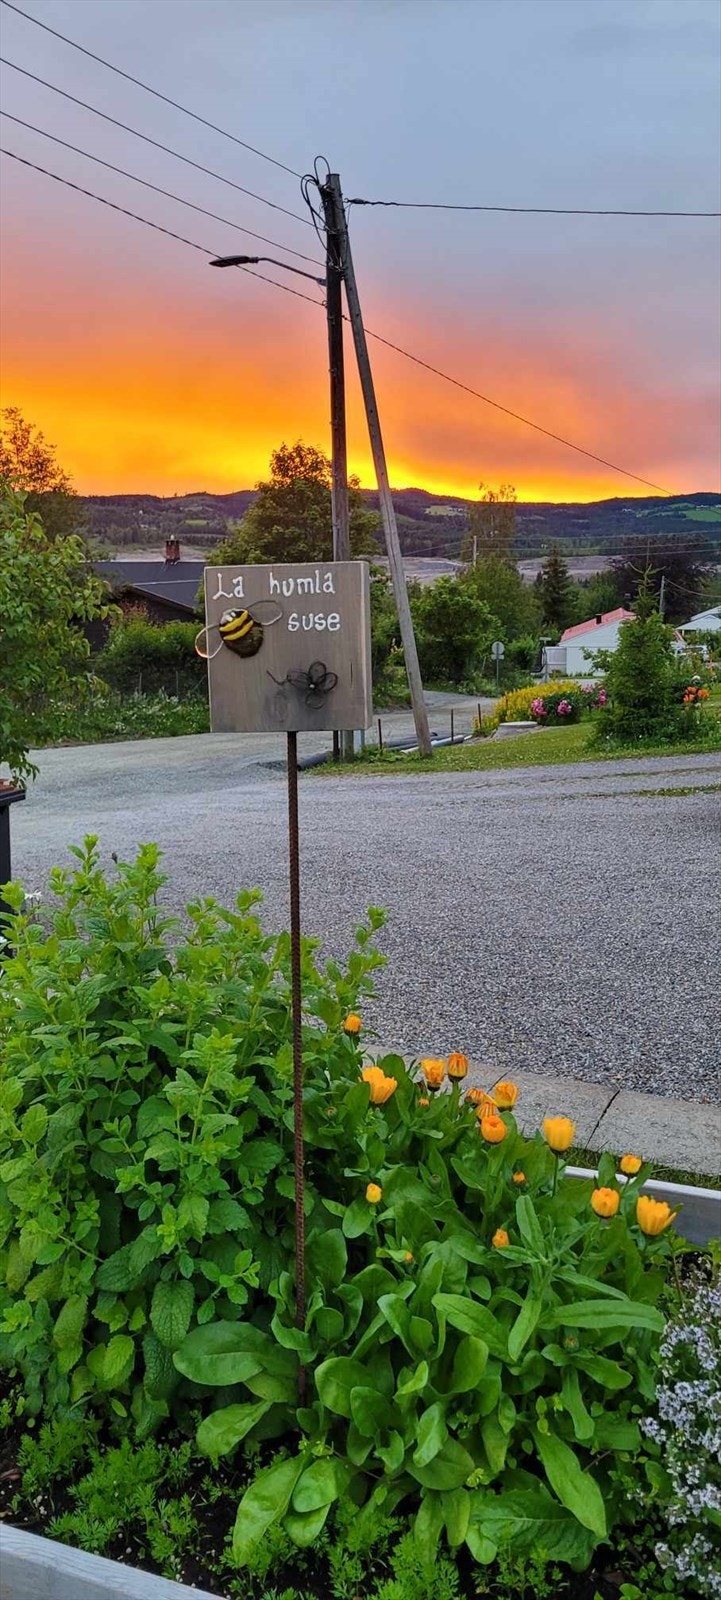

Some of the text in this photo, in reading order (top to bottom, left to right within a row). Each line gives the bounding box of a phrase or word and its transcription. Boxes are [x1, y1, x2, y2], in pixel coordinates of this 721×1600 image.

[212, 569, 336, 600] La humla
[287, 612, 341, 632] suse
